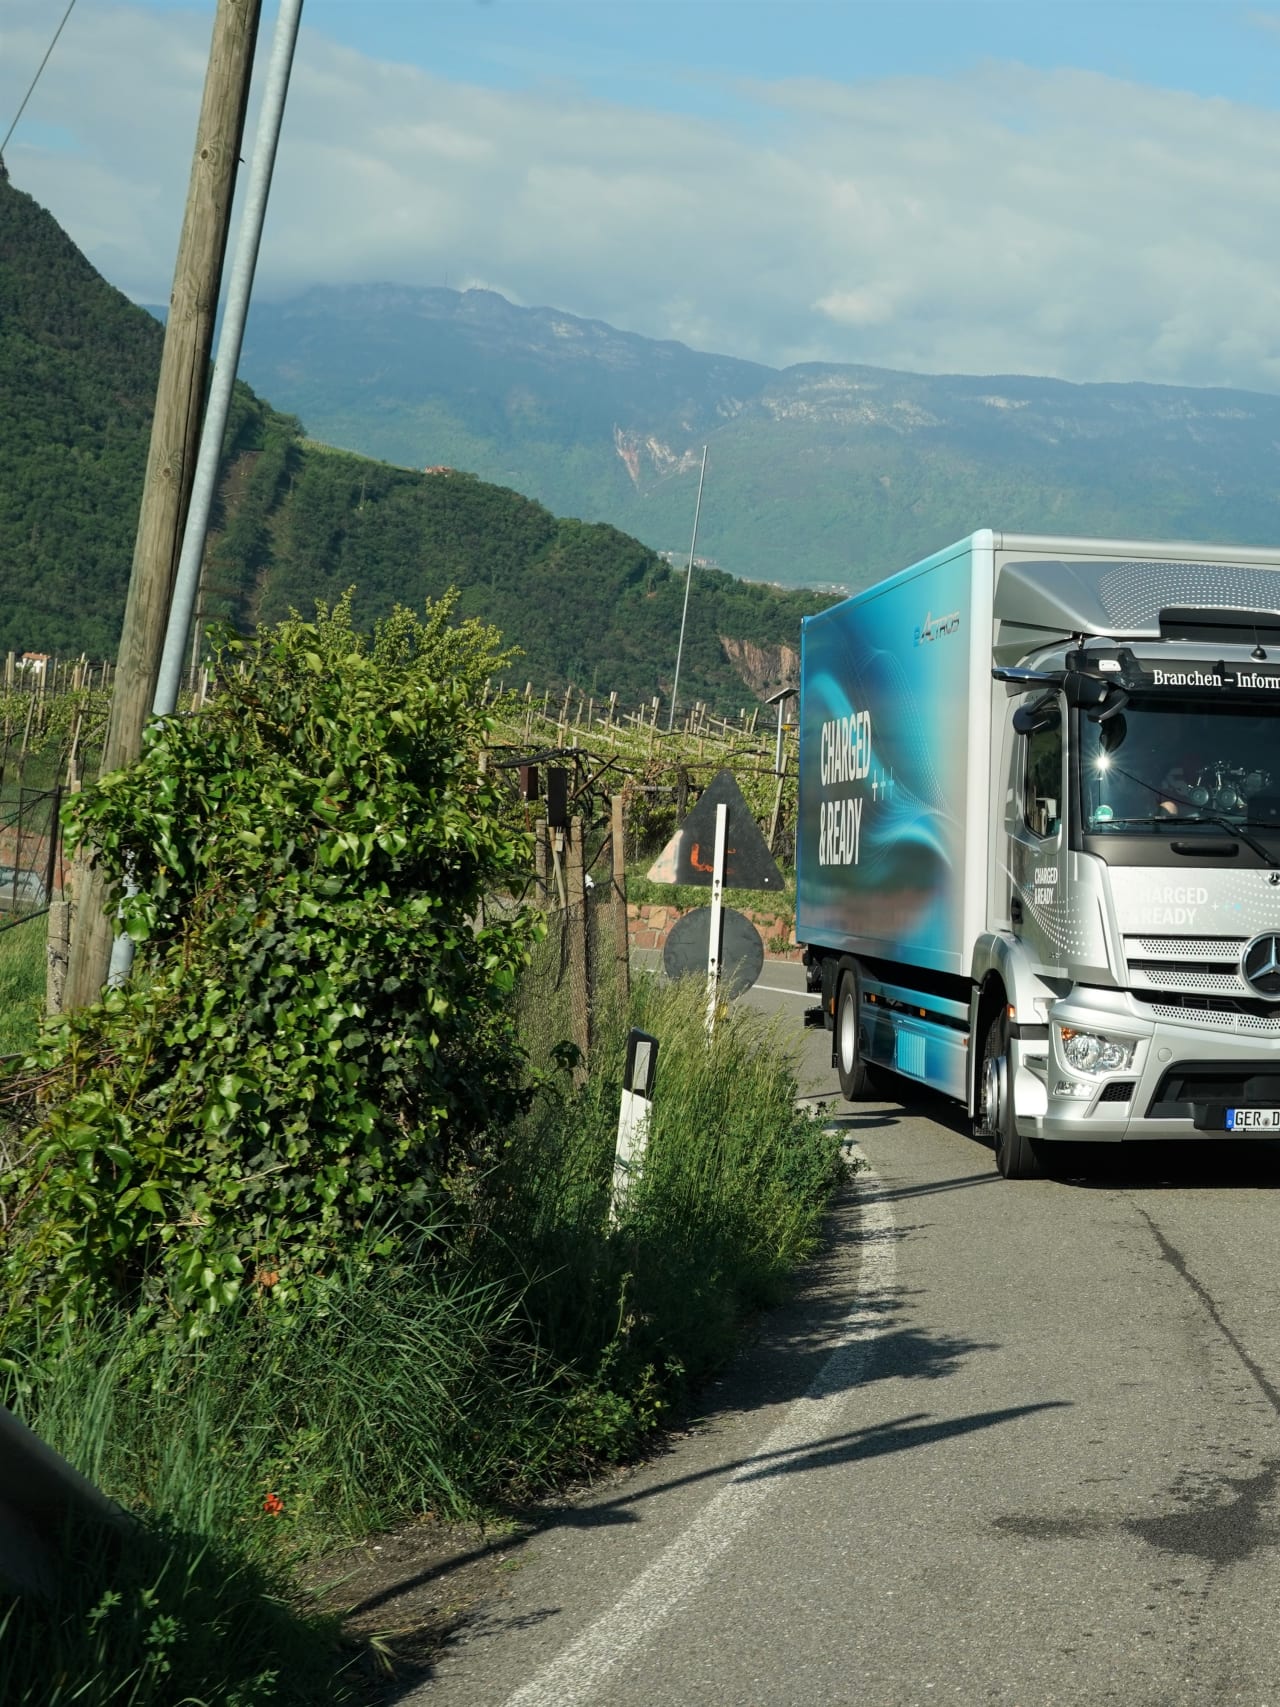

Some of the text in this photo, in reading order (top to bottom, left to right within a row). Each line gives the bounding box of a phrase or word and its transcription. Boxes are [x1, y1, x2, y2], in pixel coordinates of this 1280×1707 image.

[820, 710, 872, 786] CHARGED
[818, 797, 863, 866] &READY
[1034, 867, 1058, 885] CHARGED
[1131, 887, 1209, 905] HARGED
[1235, 1111, 1261, 1126] GER
